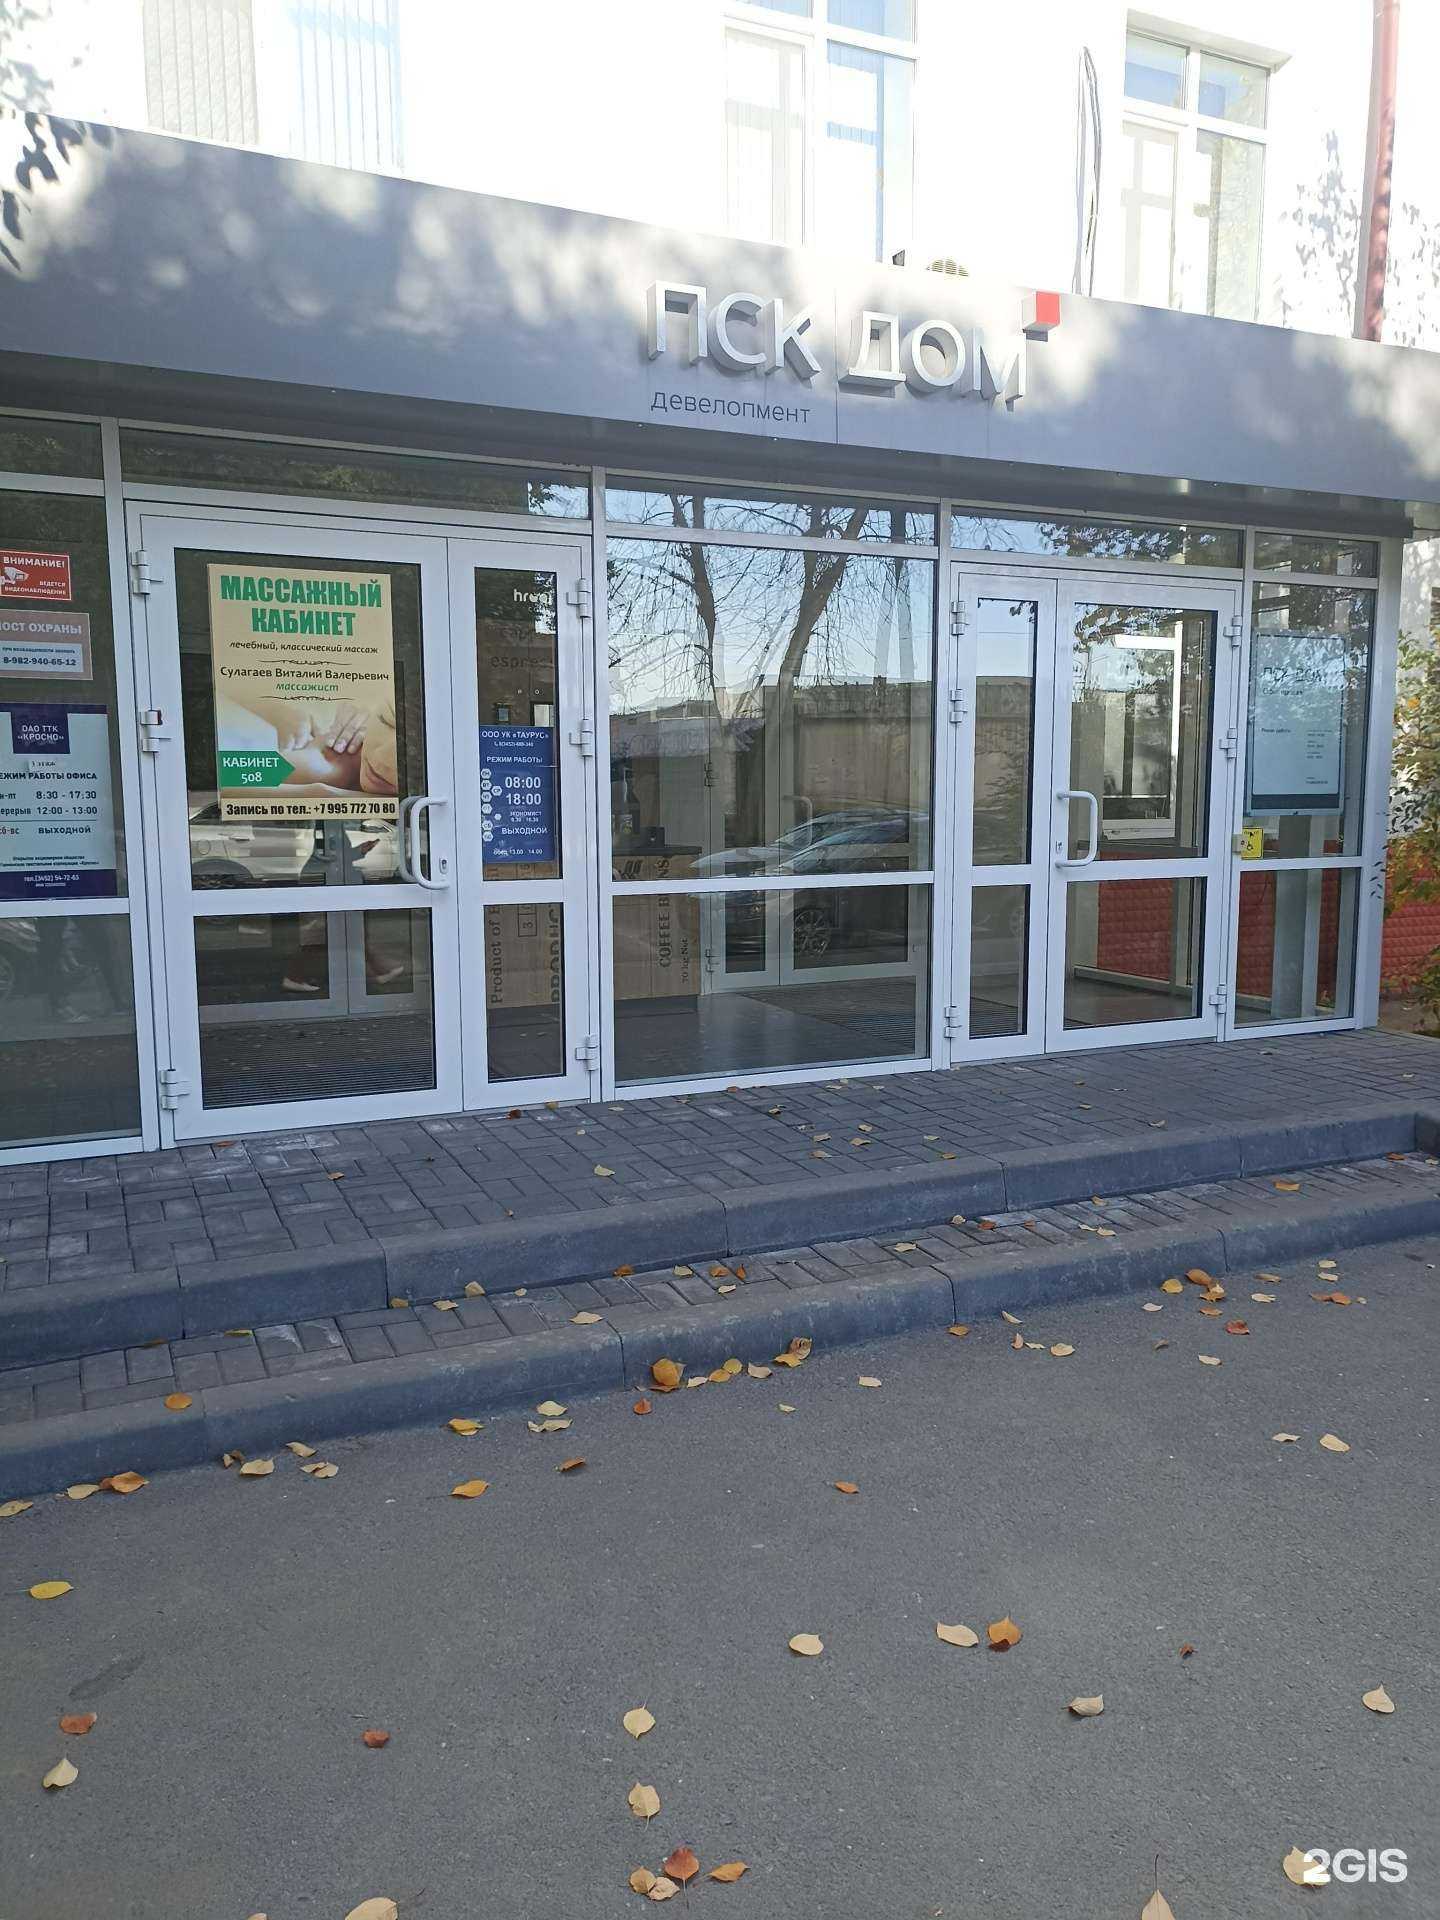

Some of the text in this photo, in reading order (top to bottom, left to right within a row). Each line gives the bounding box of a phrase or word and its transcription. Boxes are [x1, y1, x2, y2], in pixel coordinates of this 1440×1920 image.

[648, 280, 1028, 398] ПСК ДОМ
[651, 390, 811, 424] девелопмент
[3, 556, 65, 569] ВНИМАНИЕ!
[4, 586, 66, 595] ВИДЕОНАБЛЮДЕНИЕ
[220, 575, 382, 608] МАССАЖНЫЙ
[251, 608, 356, 636] КАБИНЕТ
[28, 623, 82, 635] ОХРАНЫ
[229, 640, 378, 655] лечебный, классический массаж
[220, 666, 389, 682] Сулагаев Виталий Валерьевич
[276, 682, 339, 693] массажист
[17, 733, 64, 741] «КРОСНО»
[513, 731, 549, 739] «ТАУРУС»
[223, 757, 279, 768] КАБИНЕТ
[0, 772, 97, 780] ЕЖИМ РАБОТЫ ОФИСА
[241, 772, 262, 784] 508
[505, 776, 541, 788] 08:00
[36, 790, 58, 799] 8:30
[69, 790, 97, 799] 17:30
[505, 793, 541, 805] 18:00
[0, 808, 31, 816] ерерыв
[36, 806, 63, 815] 12:00
[72, 806, 98, 815] 13:00
[226, 803, 396, 816] Запись по тел.: +7 995 772 70 80
[38, 825, 91, 834] выходной
[501, 827, 548, 835] ВЫХОДНОЙ
[489, 918, 501, 939] of
[659, 911, 671, 967] COFFEE
[490, 942, 503, 1004] Product
